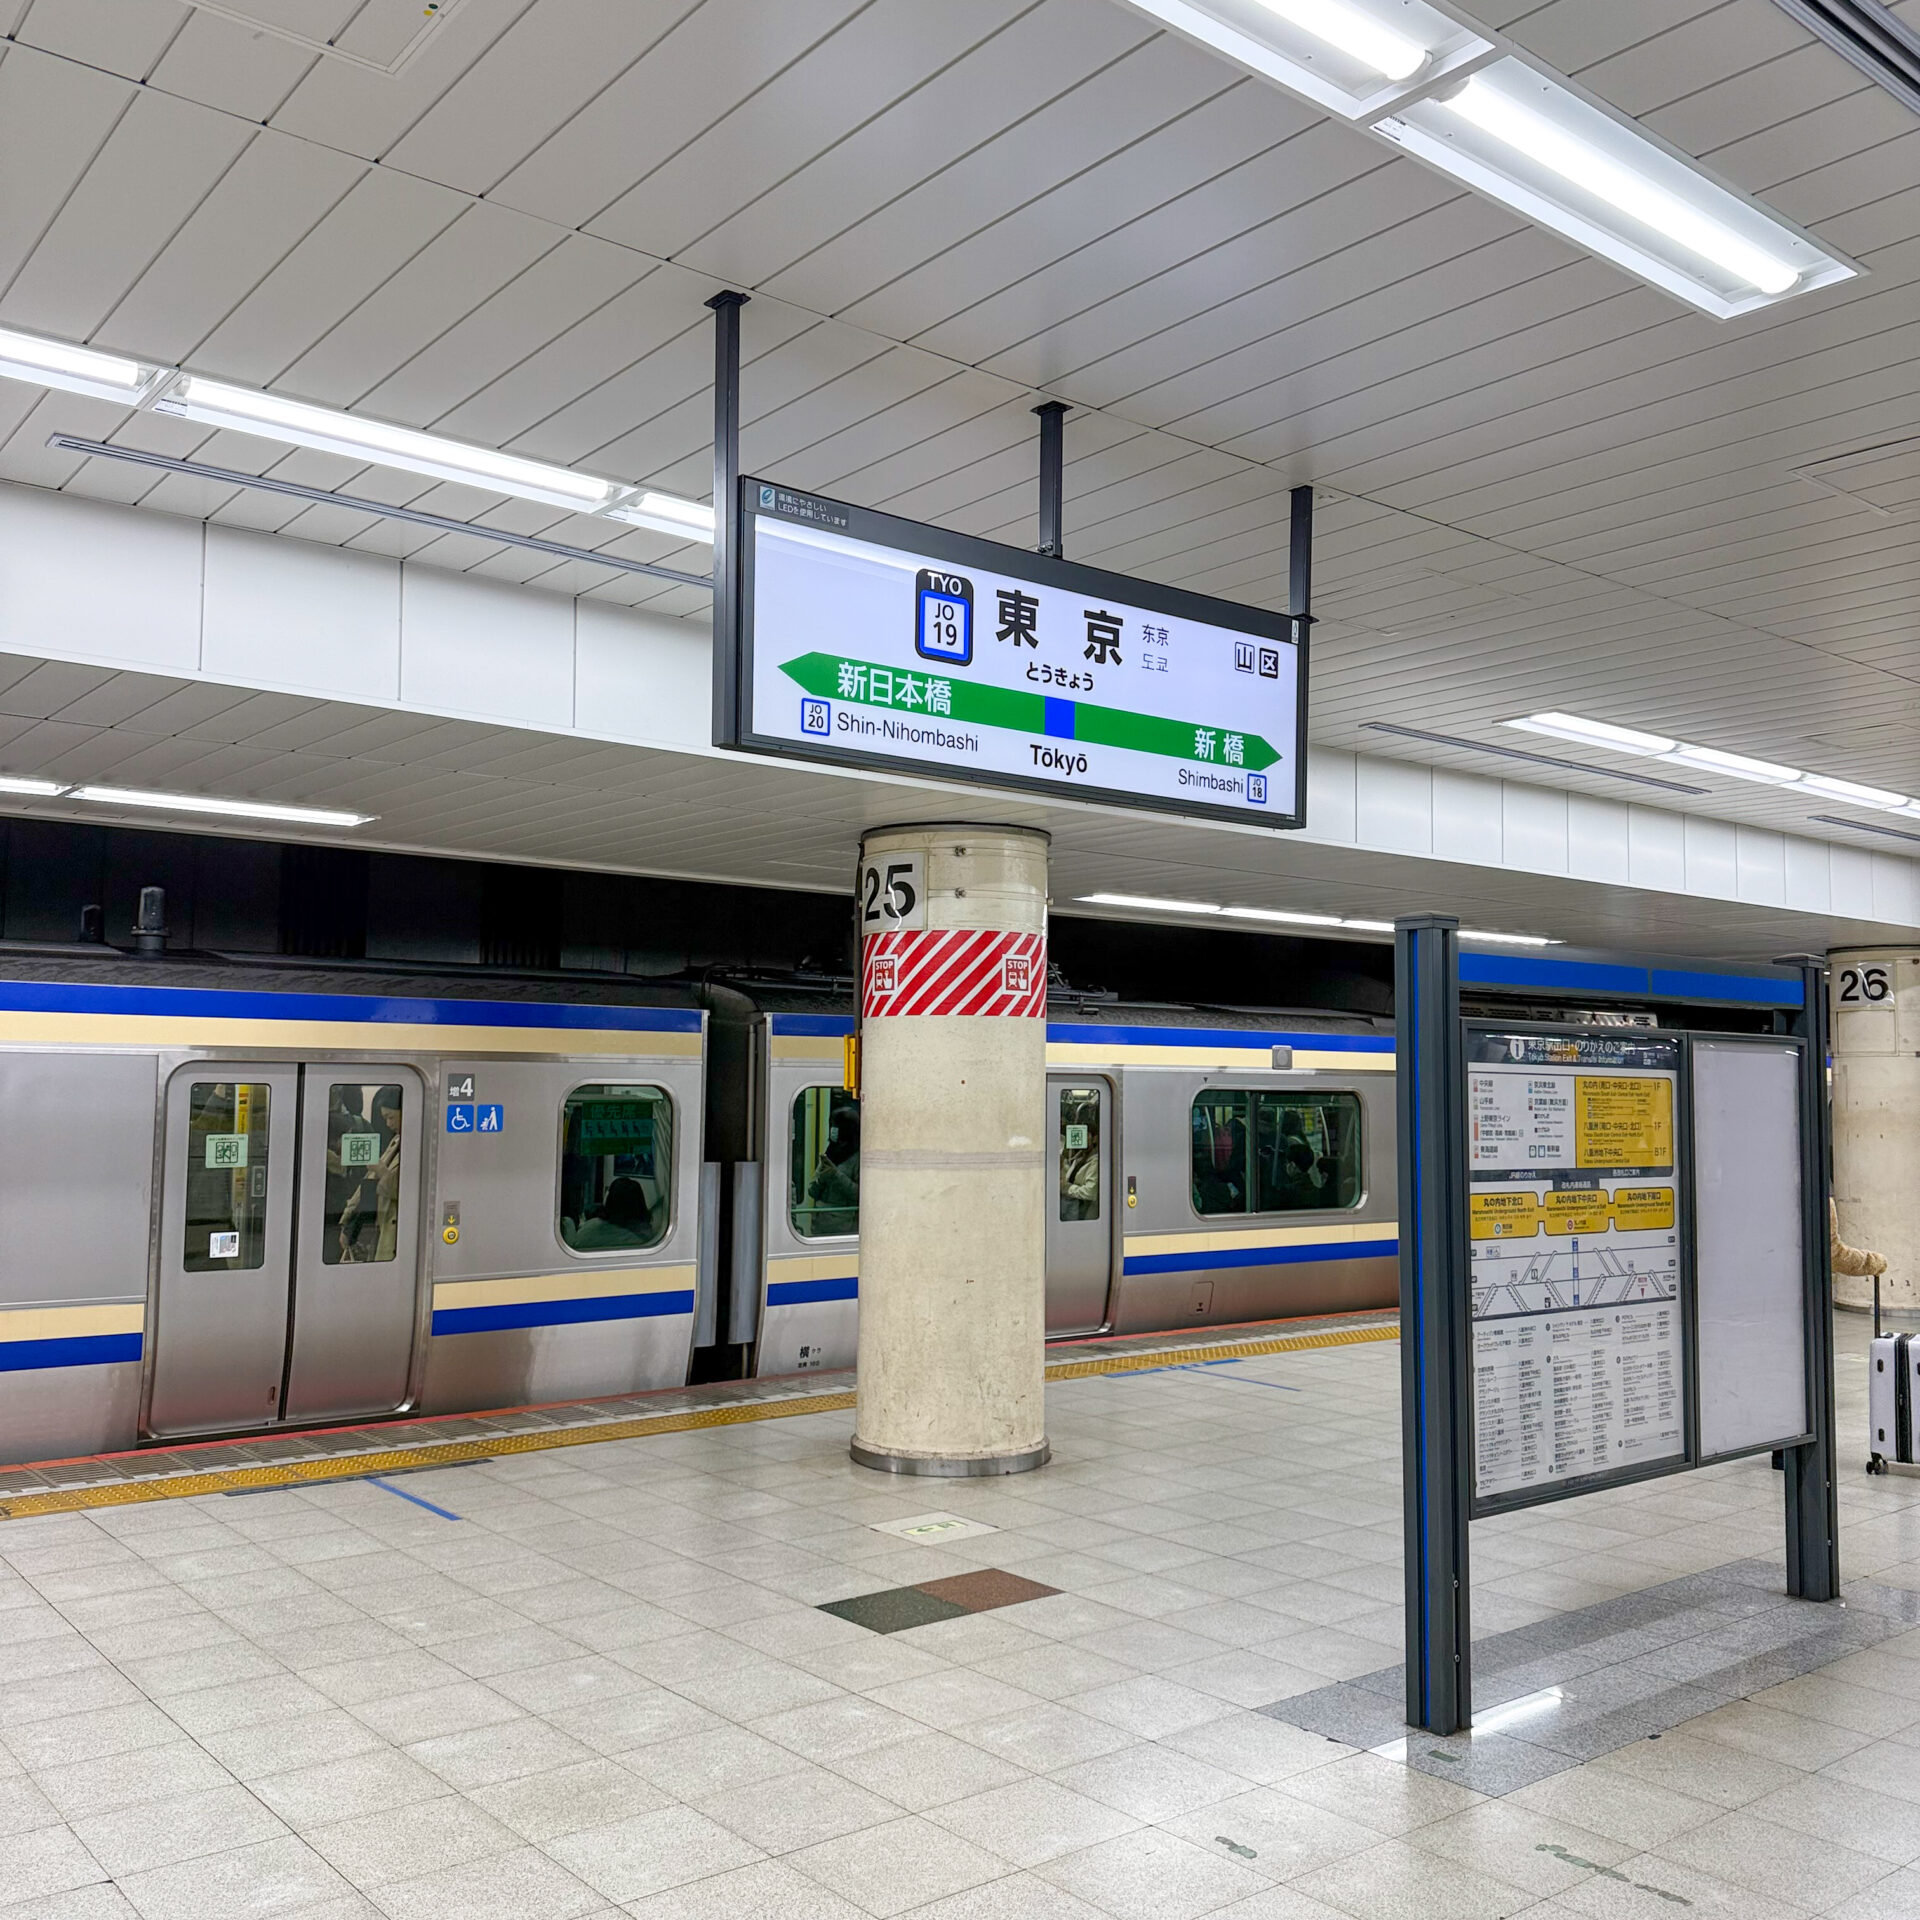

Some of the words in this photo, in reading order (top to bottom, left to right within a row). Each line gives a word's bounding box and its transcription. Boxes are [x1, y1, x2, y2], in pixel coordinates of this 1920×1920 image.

[778, 492, 827, 512] 環境にやさしい
[778, 503, 847, 527] LEDを使用しています
[927, 572, 962, 596] TYO
[934, 603, 955, 621] JO
[933, 621, 957, 646] 19
[995, 589, 1124, 667] 東京
[1141, 623, 1170, 647] 东京
[1141, 653, 1169, 673] 도쿄
[837, 661, 952, 715] 新日本橋
[1026, 661, 1095, 692] とうきょう
[808, 714, 825, 729] 20
[809, 704, 823, 715] JO
[836, 711, 979, 752] Shin-Nihombashi
[1194, 728, 1244, 766] 新橋
[1029, 744, 1088, 776] Tōkyō
[1178, 768, 1244, 794] Shimbashi
[1251, 786, 1263, 799] 18
[864, 863, 916, 922] 25
[875, 960, 894, 970] STOP
[1007, 960, 1028, 970] STOP
[1840, 968, 1889, 1002] 26
